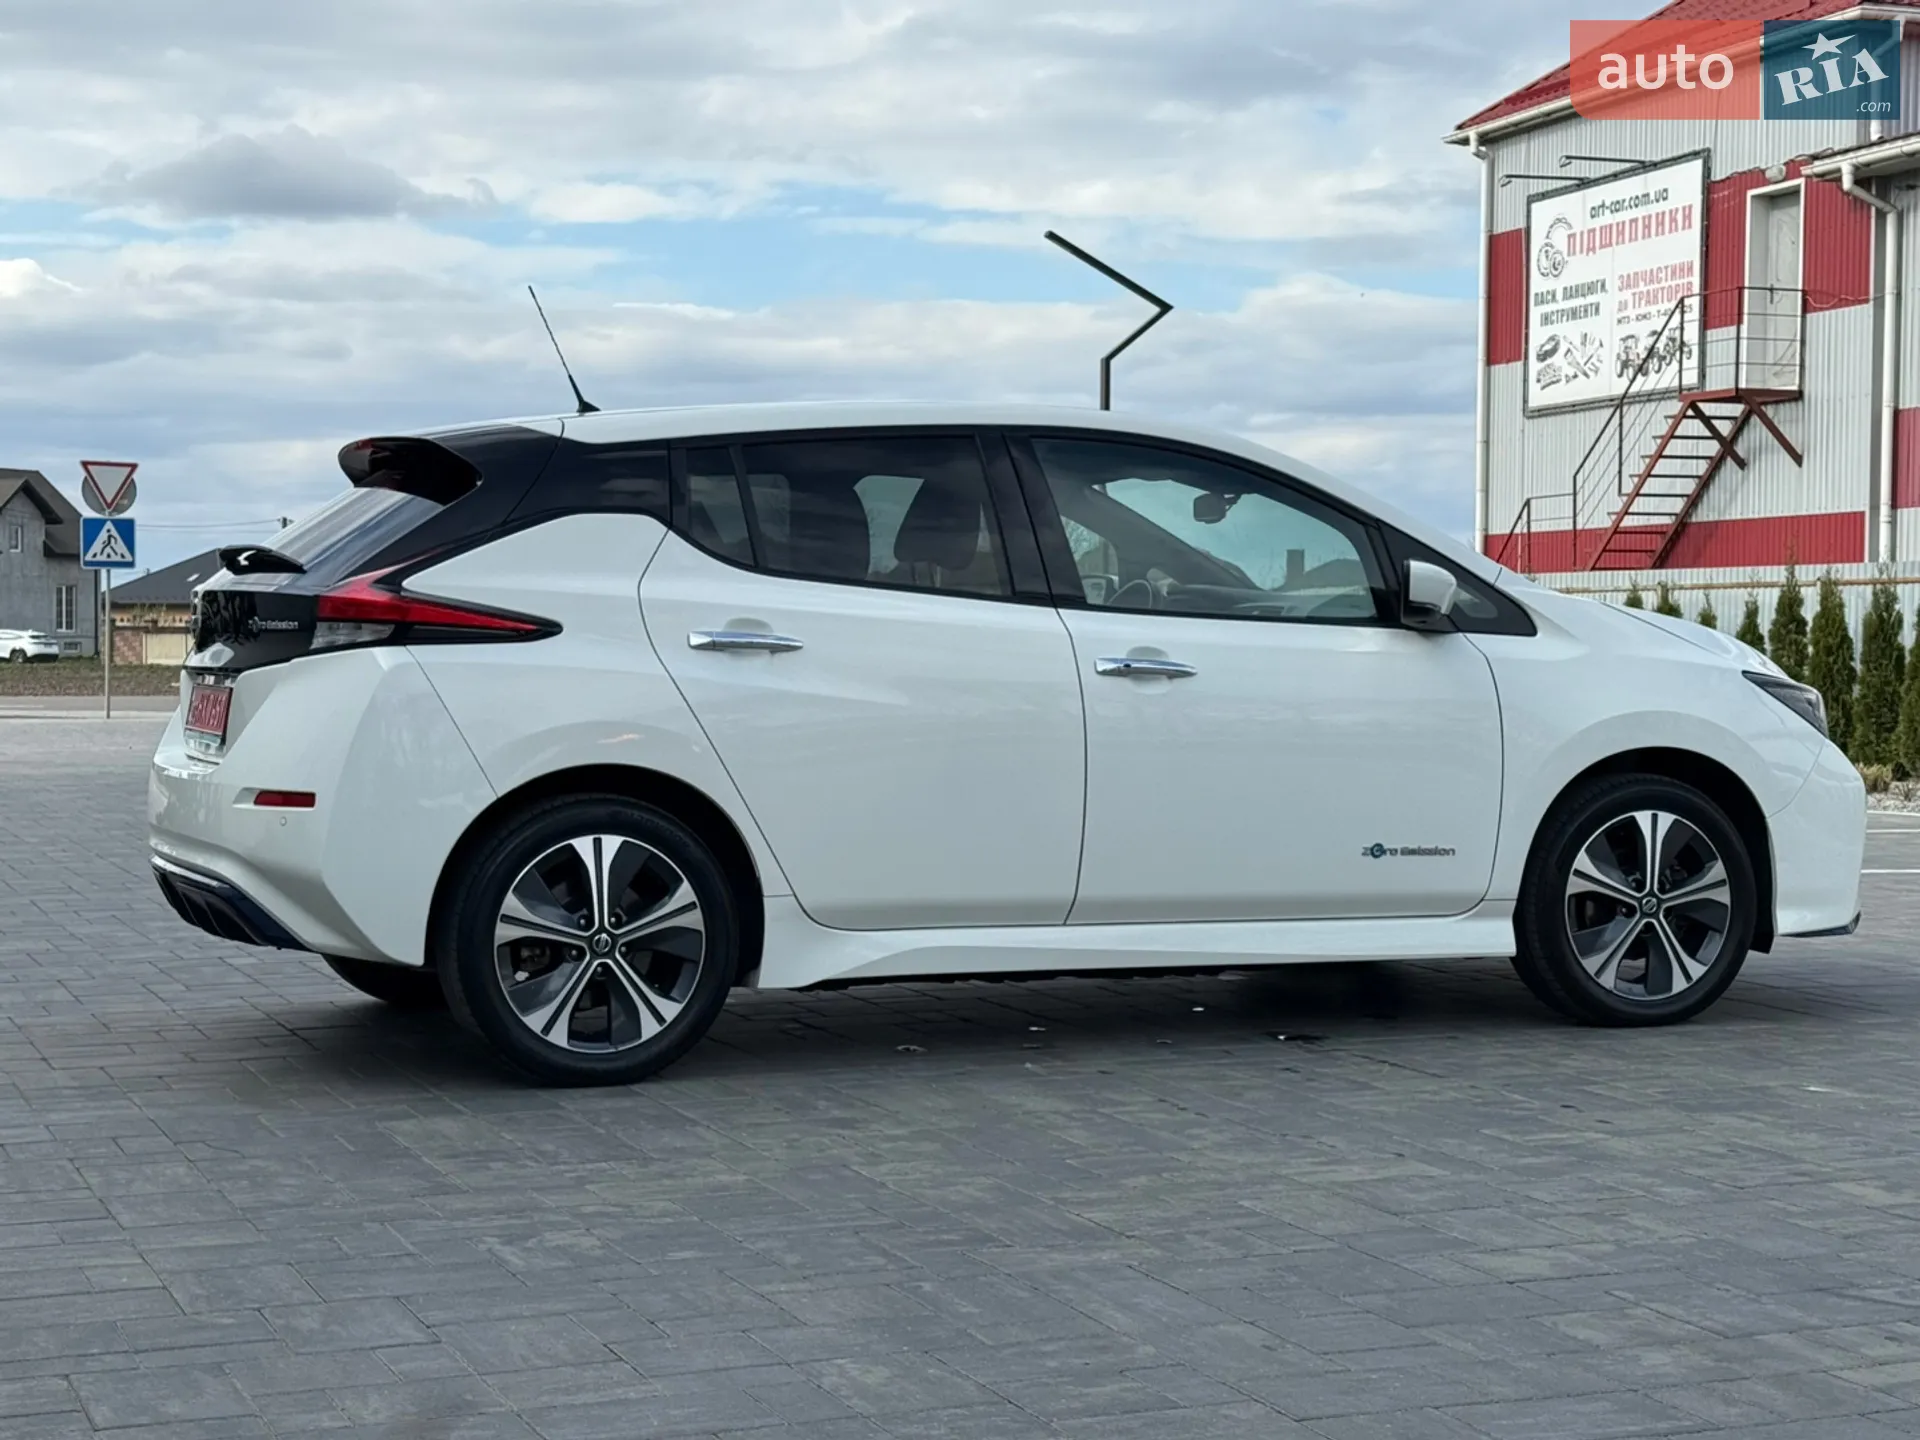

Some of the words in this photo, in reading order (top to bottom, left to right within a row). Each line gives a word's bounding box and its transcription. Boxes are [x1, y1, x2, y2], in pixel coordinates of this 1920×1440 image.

[1590, 188, 1669, 219] art-car.com.ua
[1567, 204, 1693, 257] ПІДШИПНИКИ
[1618, 260, 1694, 292] ЗАПЧАСТИНИ
[1534, 287, 1559, 307] ПАСИ,
[1561, 278, 1608, 302] ЛАНЦЮГИ,
[1631, 281, 1693, 309] ТРАКТОРІВ
[1540, 301, 1600, 327] ІНСТРУМЕНТИ
